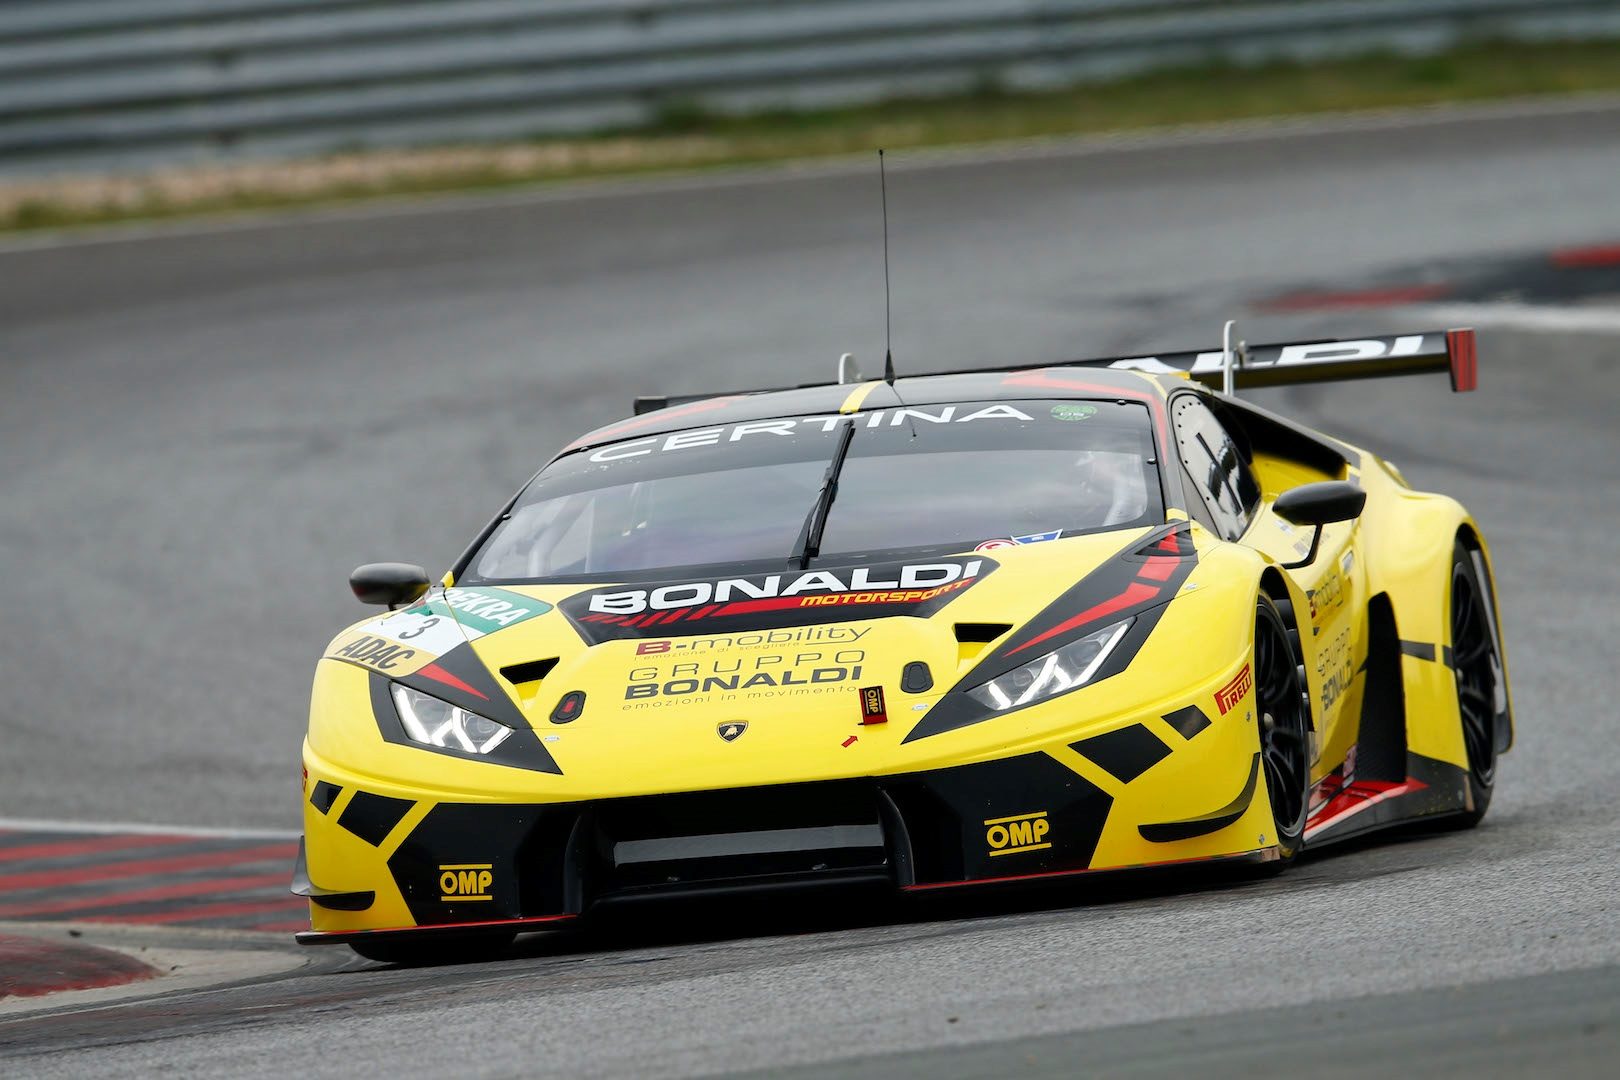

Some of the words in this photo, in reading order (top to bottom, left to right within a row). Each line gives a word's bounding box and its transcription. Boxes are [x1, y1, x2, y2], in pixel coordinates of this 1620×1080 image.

[589, 403, 1035, 463] CERTINA
[589, 559, 983, 613] BONALDI
[800, 579, 971, 606] MOTORSPORT
[335, 636, 415, 669] ADAC
[636, 627, 872, 656] B-mobility
[629, 650, 865, 681] GRUPPO
[625, 665, 862, 700] BONALDI
[1214, 663, 1252, 716] PIRELLI
[622, 696, 711, 711] emozioni
[721, 693, 738, 702] in
[747, 686, 858, 699] movimento
[868, 690, 879, 713] OMP
[986, 819, 1050, 849] OMP
[439, 870, 493, 894] OMP
